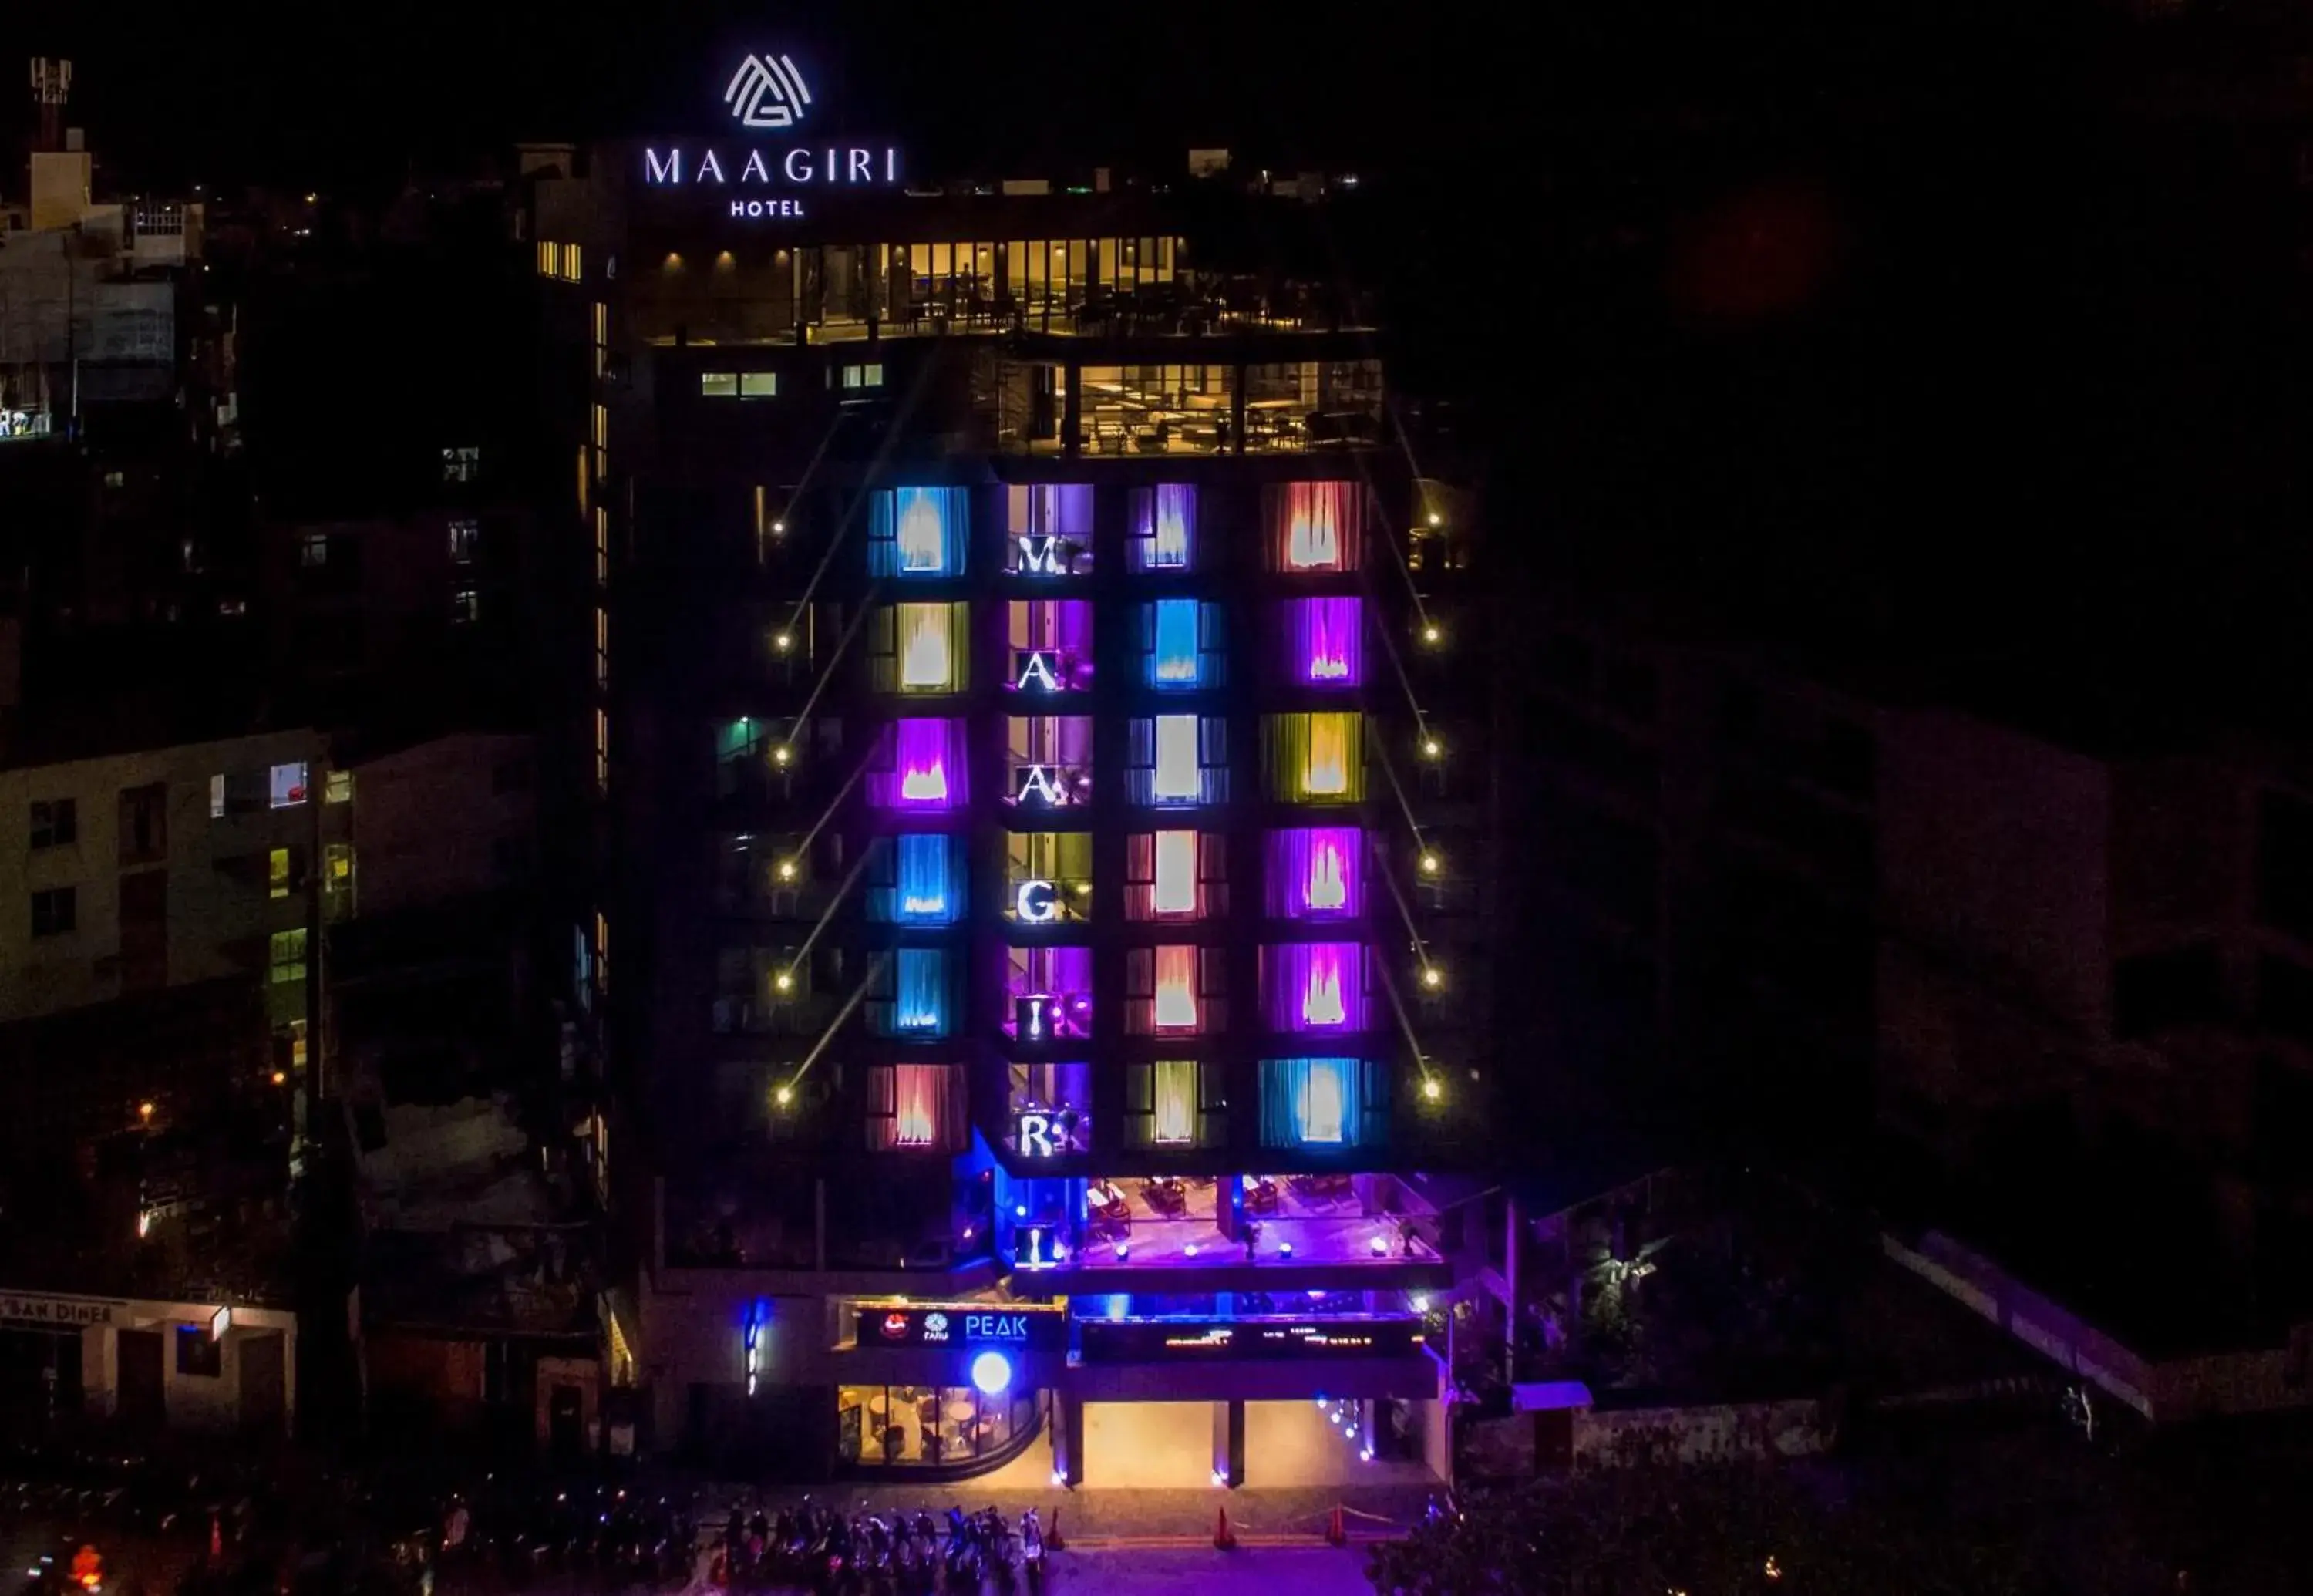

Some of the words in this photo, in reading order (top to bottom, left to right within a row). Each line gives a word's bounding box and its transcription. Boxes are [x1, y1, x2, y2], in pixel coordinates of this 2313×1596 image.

[645, 147, 895, 184] MAAGIRI
[731, 200, 804, 217] HOTEL
[965, 1315, 1028, 1336] PEAK
